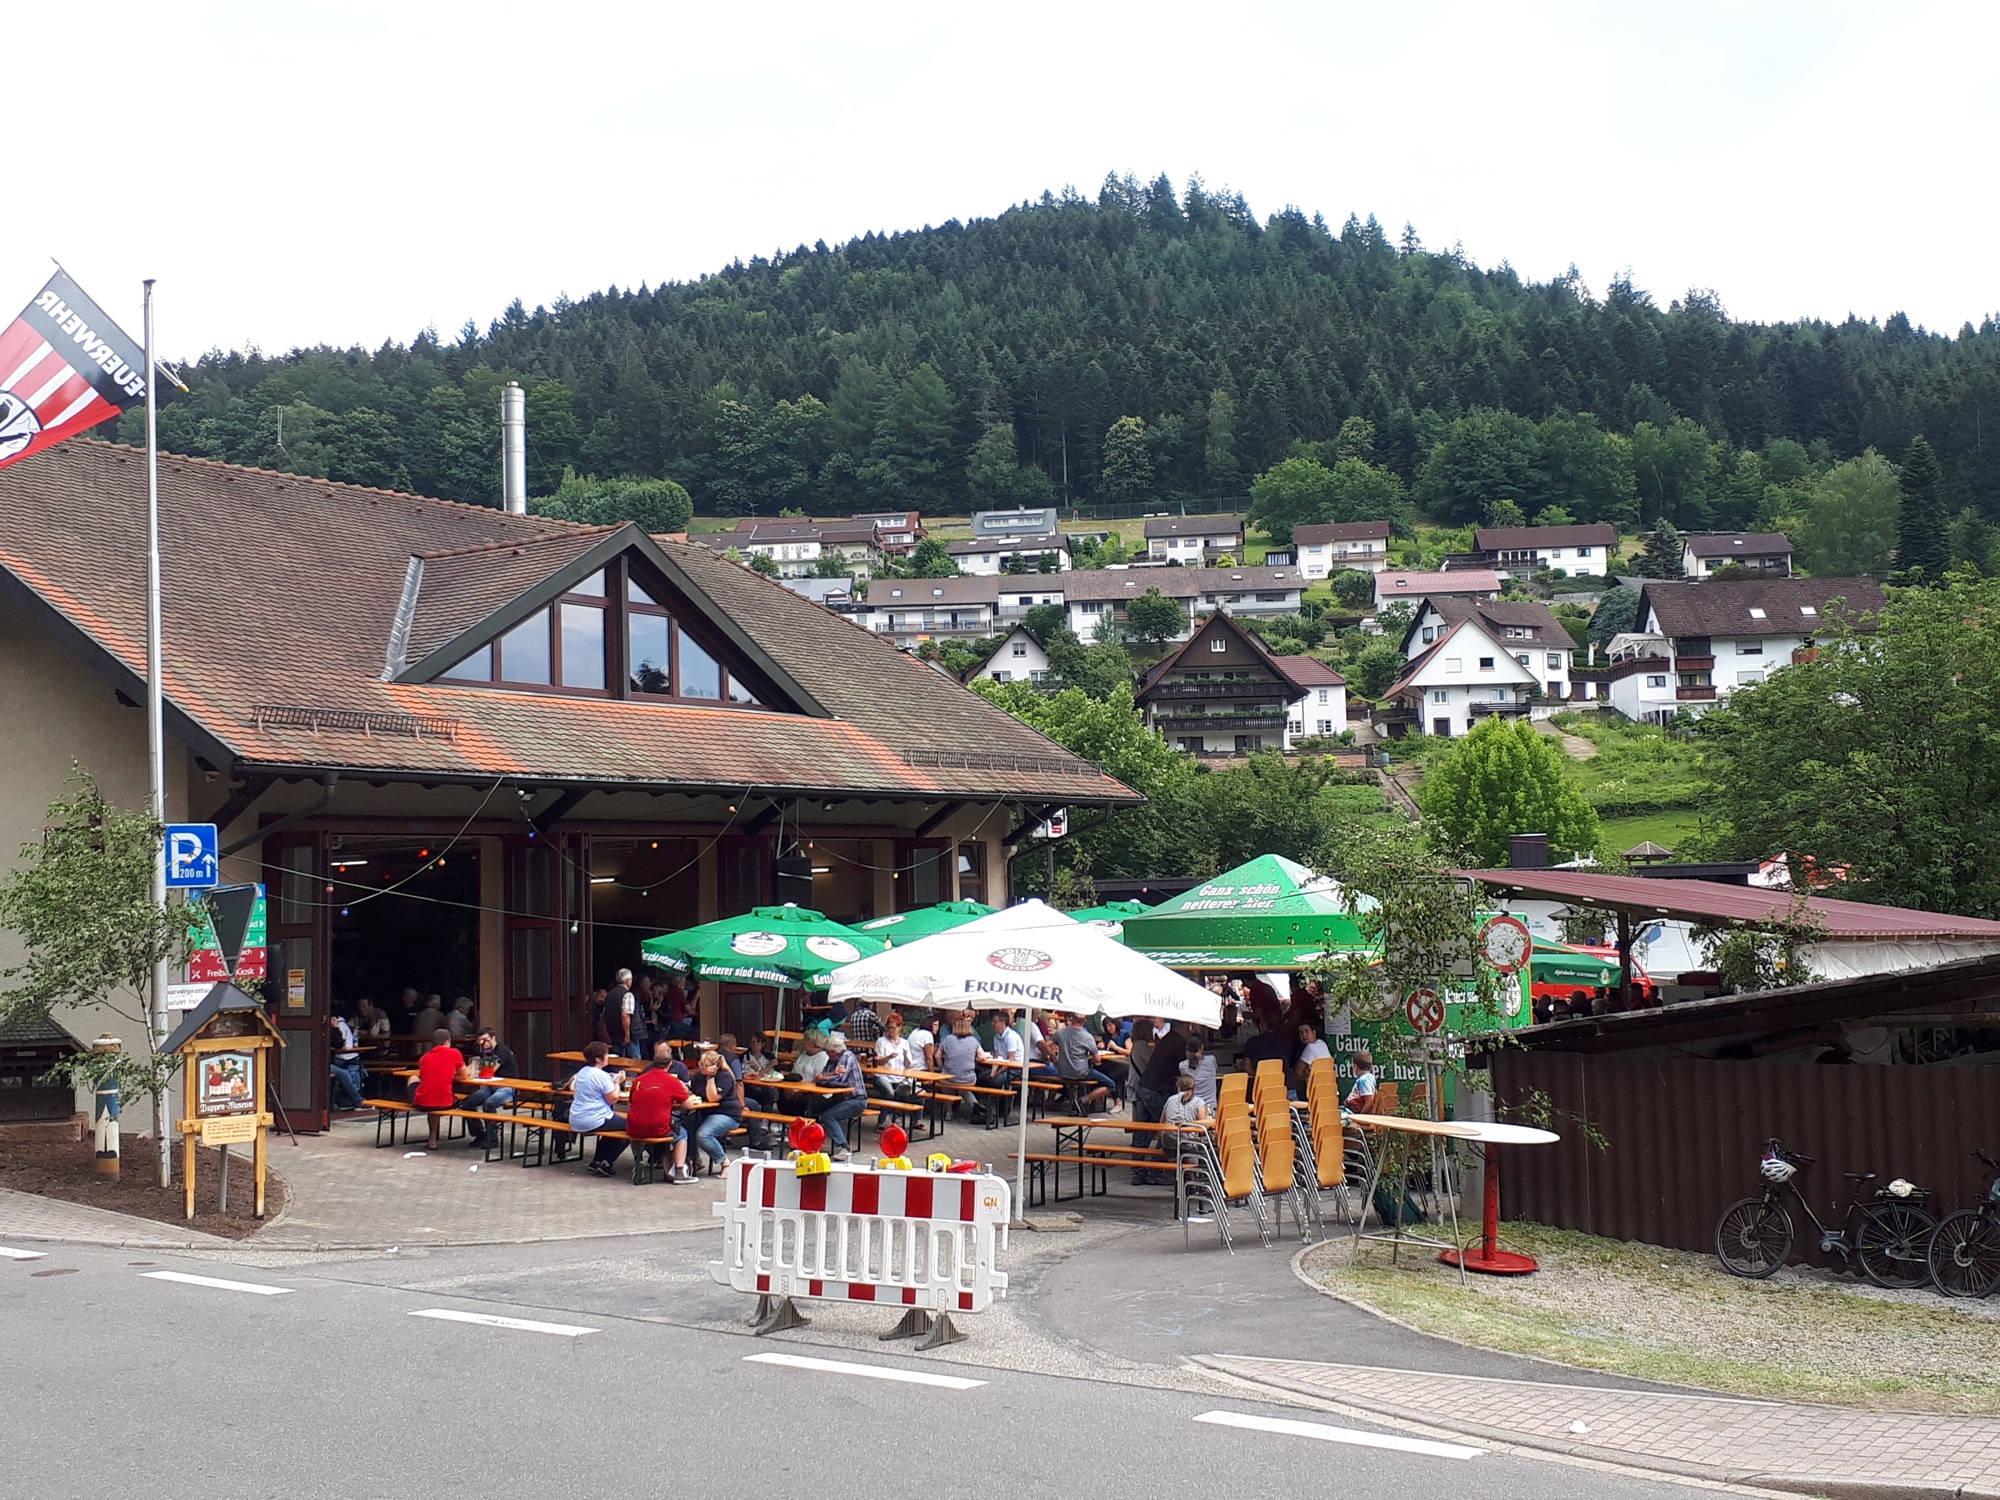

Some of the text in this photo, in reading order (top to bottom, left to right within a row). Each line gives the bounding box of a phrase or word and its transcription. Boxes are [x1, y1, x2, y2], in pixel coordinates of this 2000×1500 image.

[171, 833, 202, 879] P
[180, 868, 204, 878] 200 m
[1199, 884, 1234, 896] Ganz
[1180, 899, 1238, 911] netterer
[700, 963, 789, 984] Ketterer sind netterer.
[964, 979, 1064, 1003] ERDINGER
[1336, 1033, 1370, 1052] Ganz
[1394, 1060, 1425, 1081] hier.
